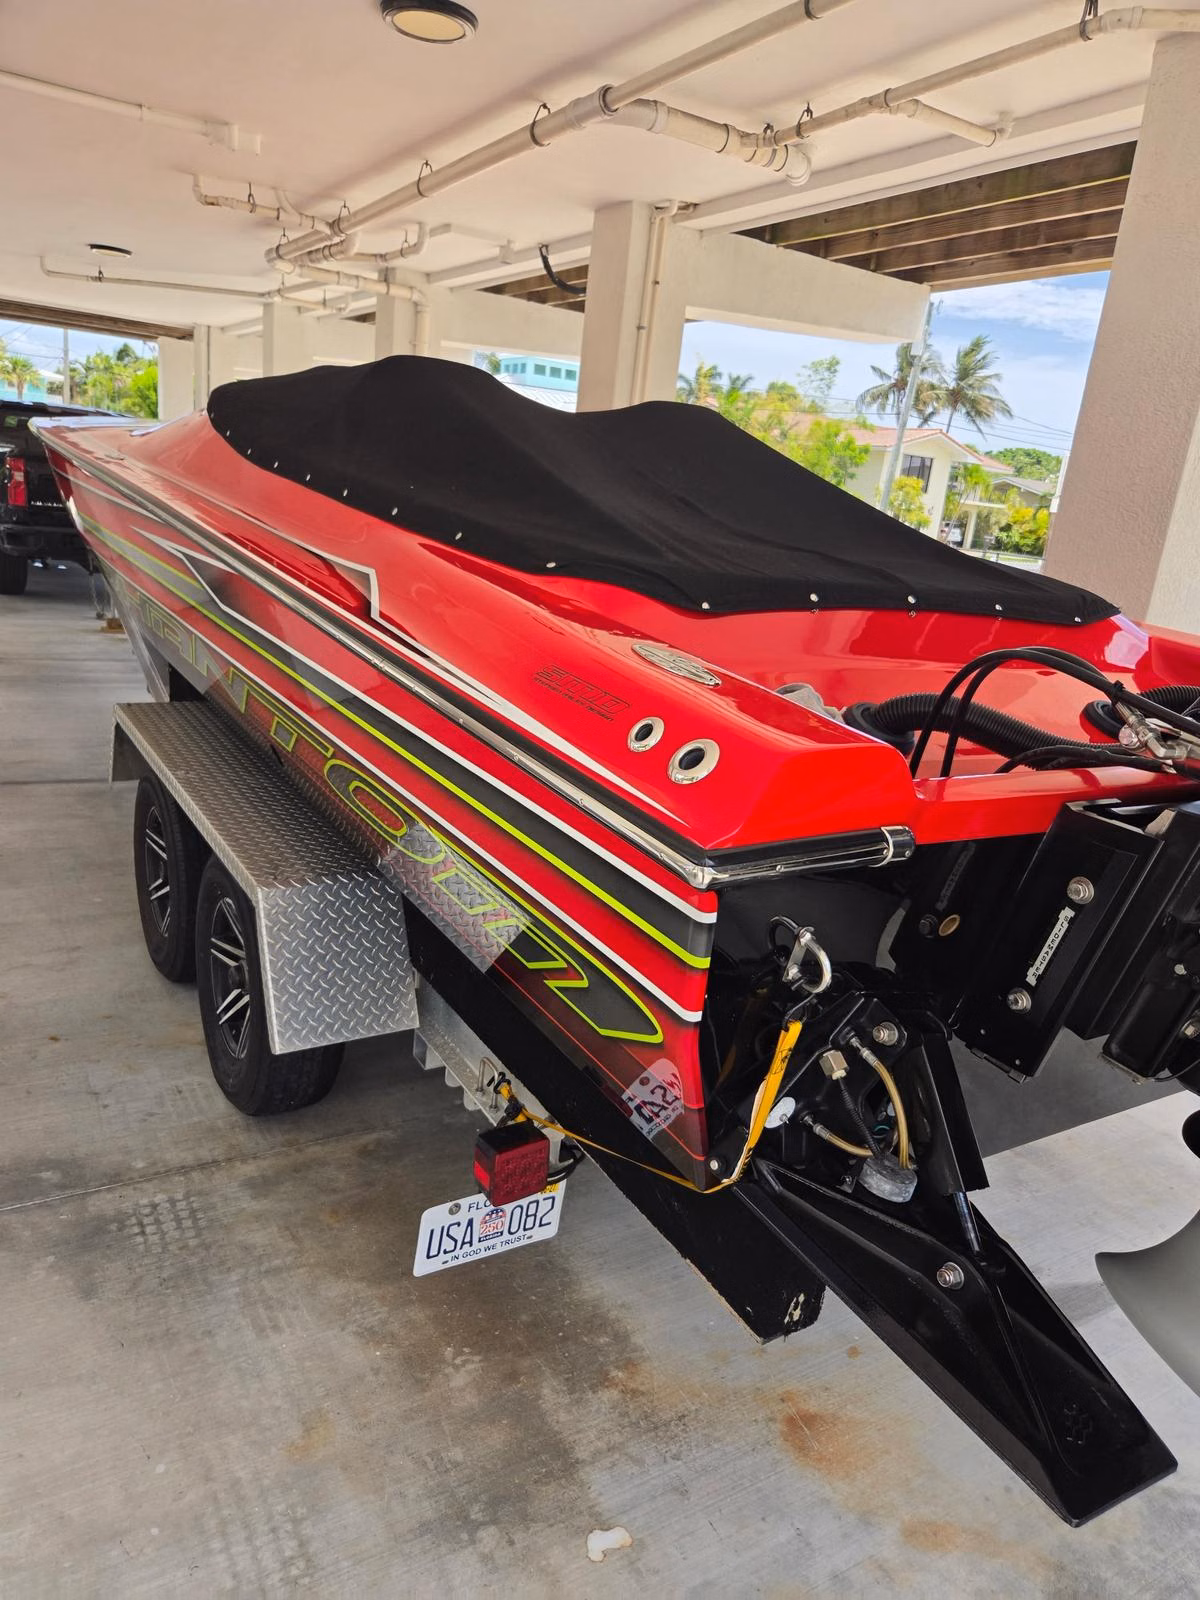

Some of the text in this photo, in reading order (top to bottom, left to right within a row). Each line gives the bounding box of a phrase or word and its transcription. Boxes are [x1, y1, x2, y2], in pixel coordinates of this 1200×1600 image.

[1032, 915, 1070, 979] SLIDEMASTER
[426, 1195, 556, 1260] USA 082
[450, 1234, 528, 1262] IN GOD WE TRUST
[480, 1220, 504, 1236] 250
